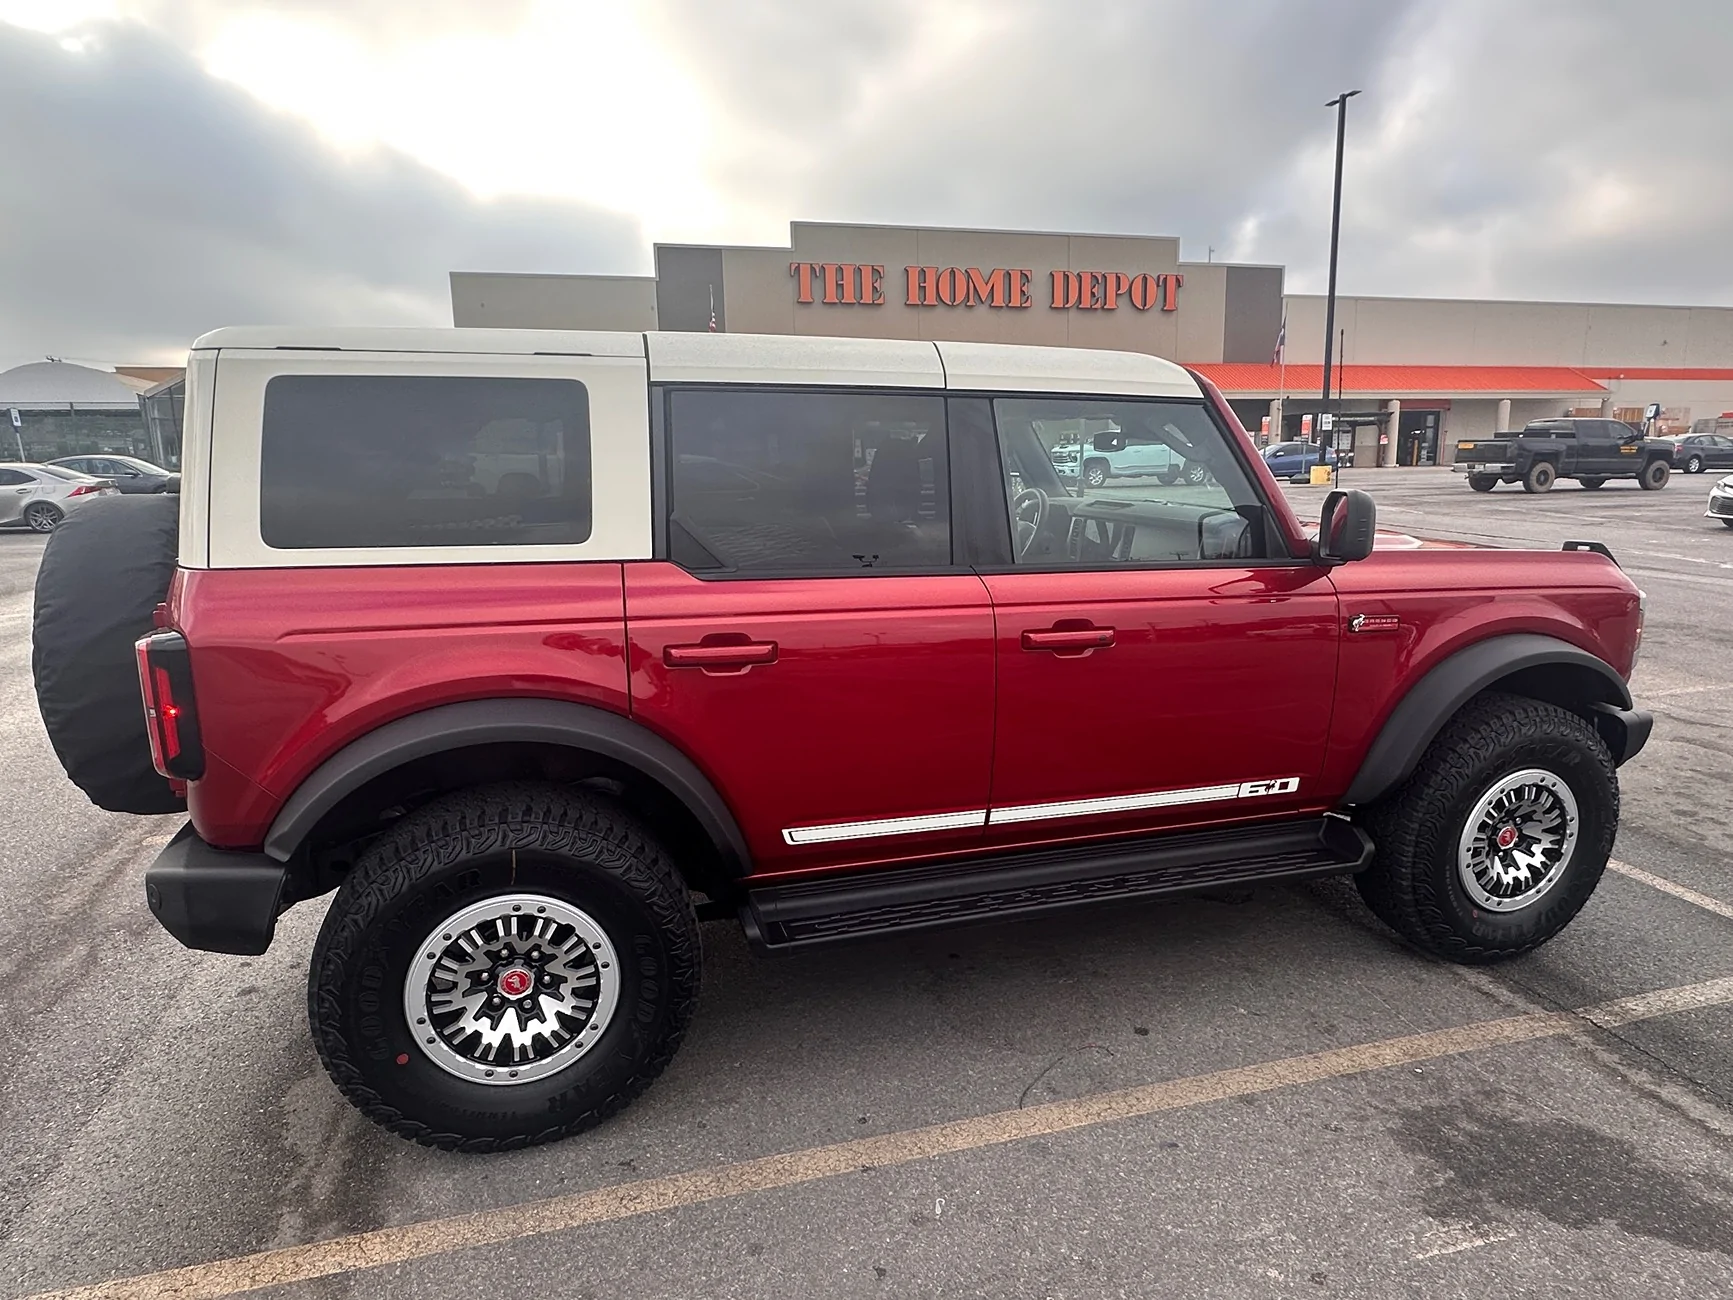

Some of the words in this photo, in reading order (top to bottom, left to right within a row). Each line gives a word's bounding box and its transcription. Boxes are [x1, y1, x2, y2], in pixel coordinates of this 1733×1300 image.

[790, 262, 885, 304] THE
[904, 265, 1032, 308] HOME
[1050, 270, 1184, 311] DEPOT
